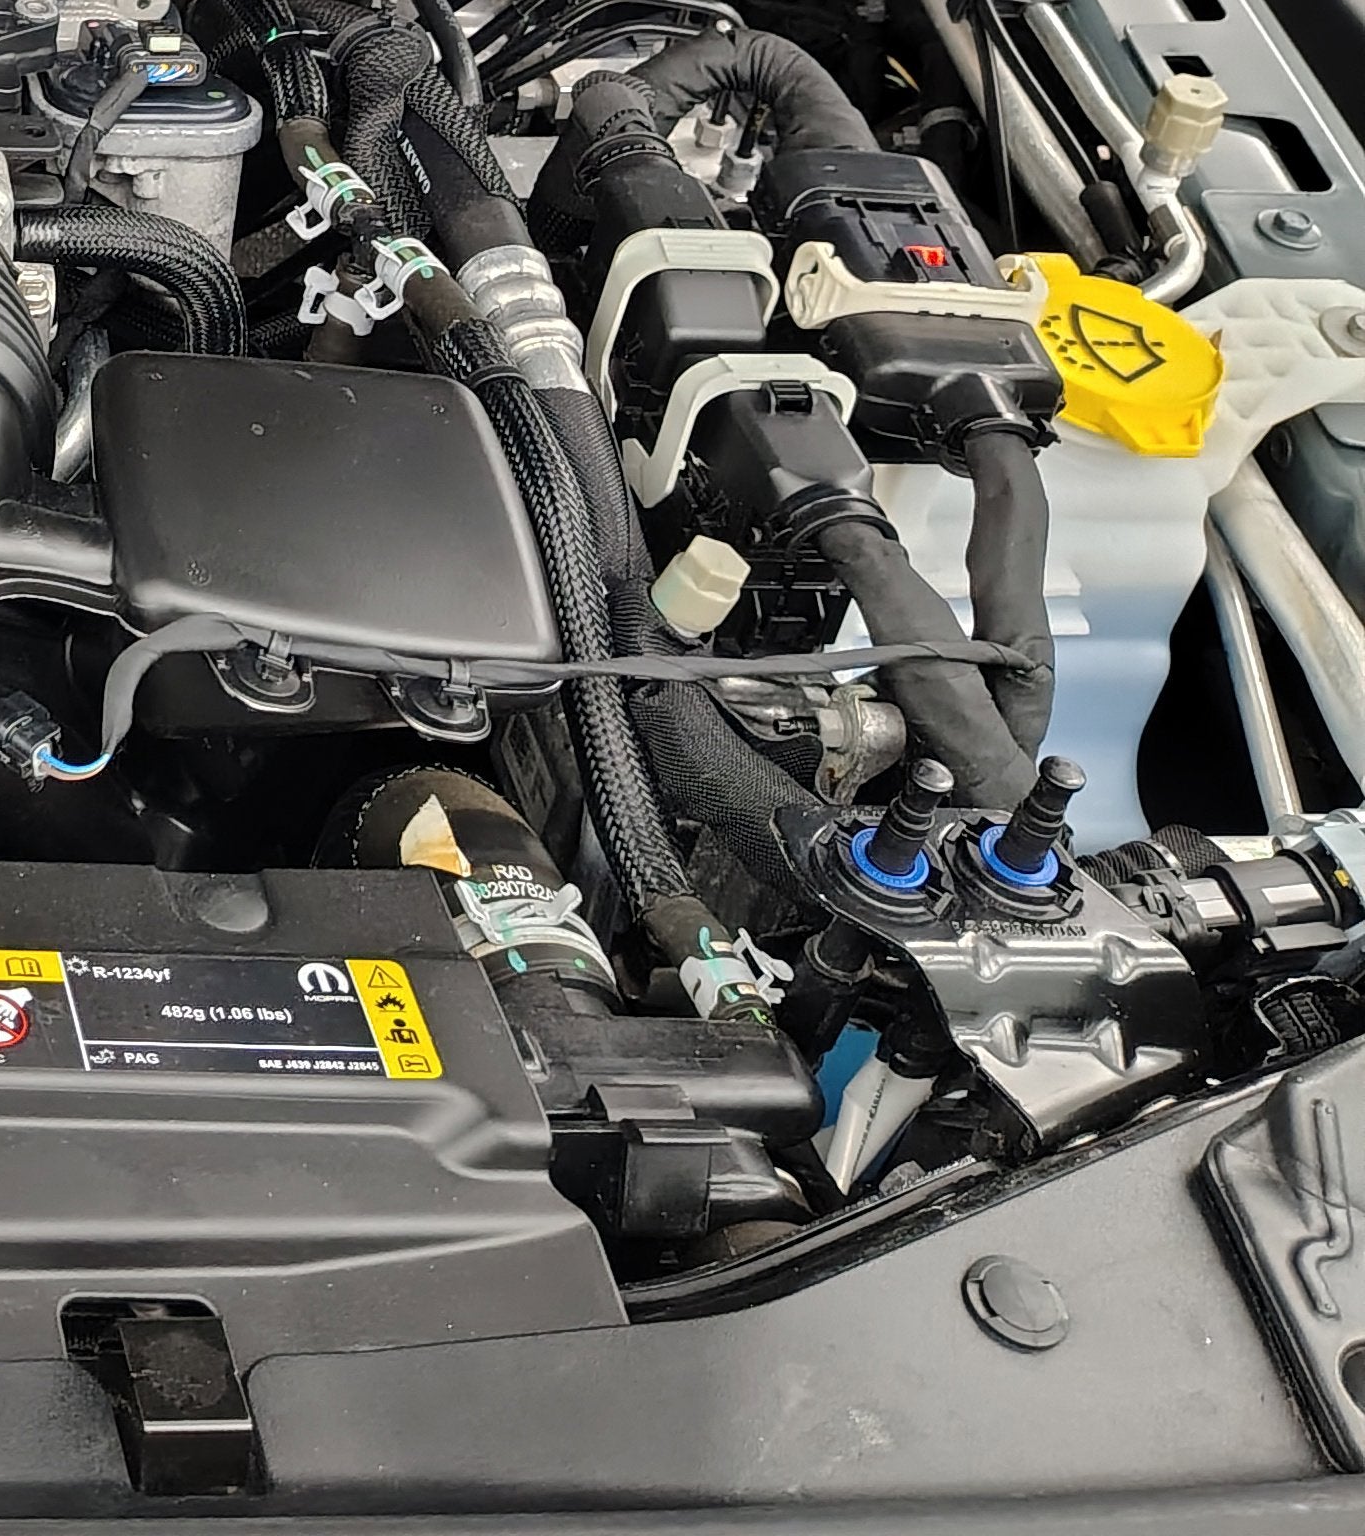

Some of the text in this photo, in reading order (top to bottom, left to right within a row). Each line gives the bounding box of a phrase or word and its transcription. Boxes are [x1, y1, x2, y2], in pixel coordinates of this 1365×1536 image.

[399, 136, 432, 195] GALAXY
[491, 864, 533, 881] RAD
[91, 964, 171, 983] R-1234yf
[303, 994, 353, 1003] MOPAR
[160, 1004, 293, 1024] 482g (1.06 lbs)
[123, 1050, 161, 1066] PAG
